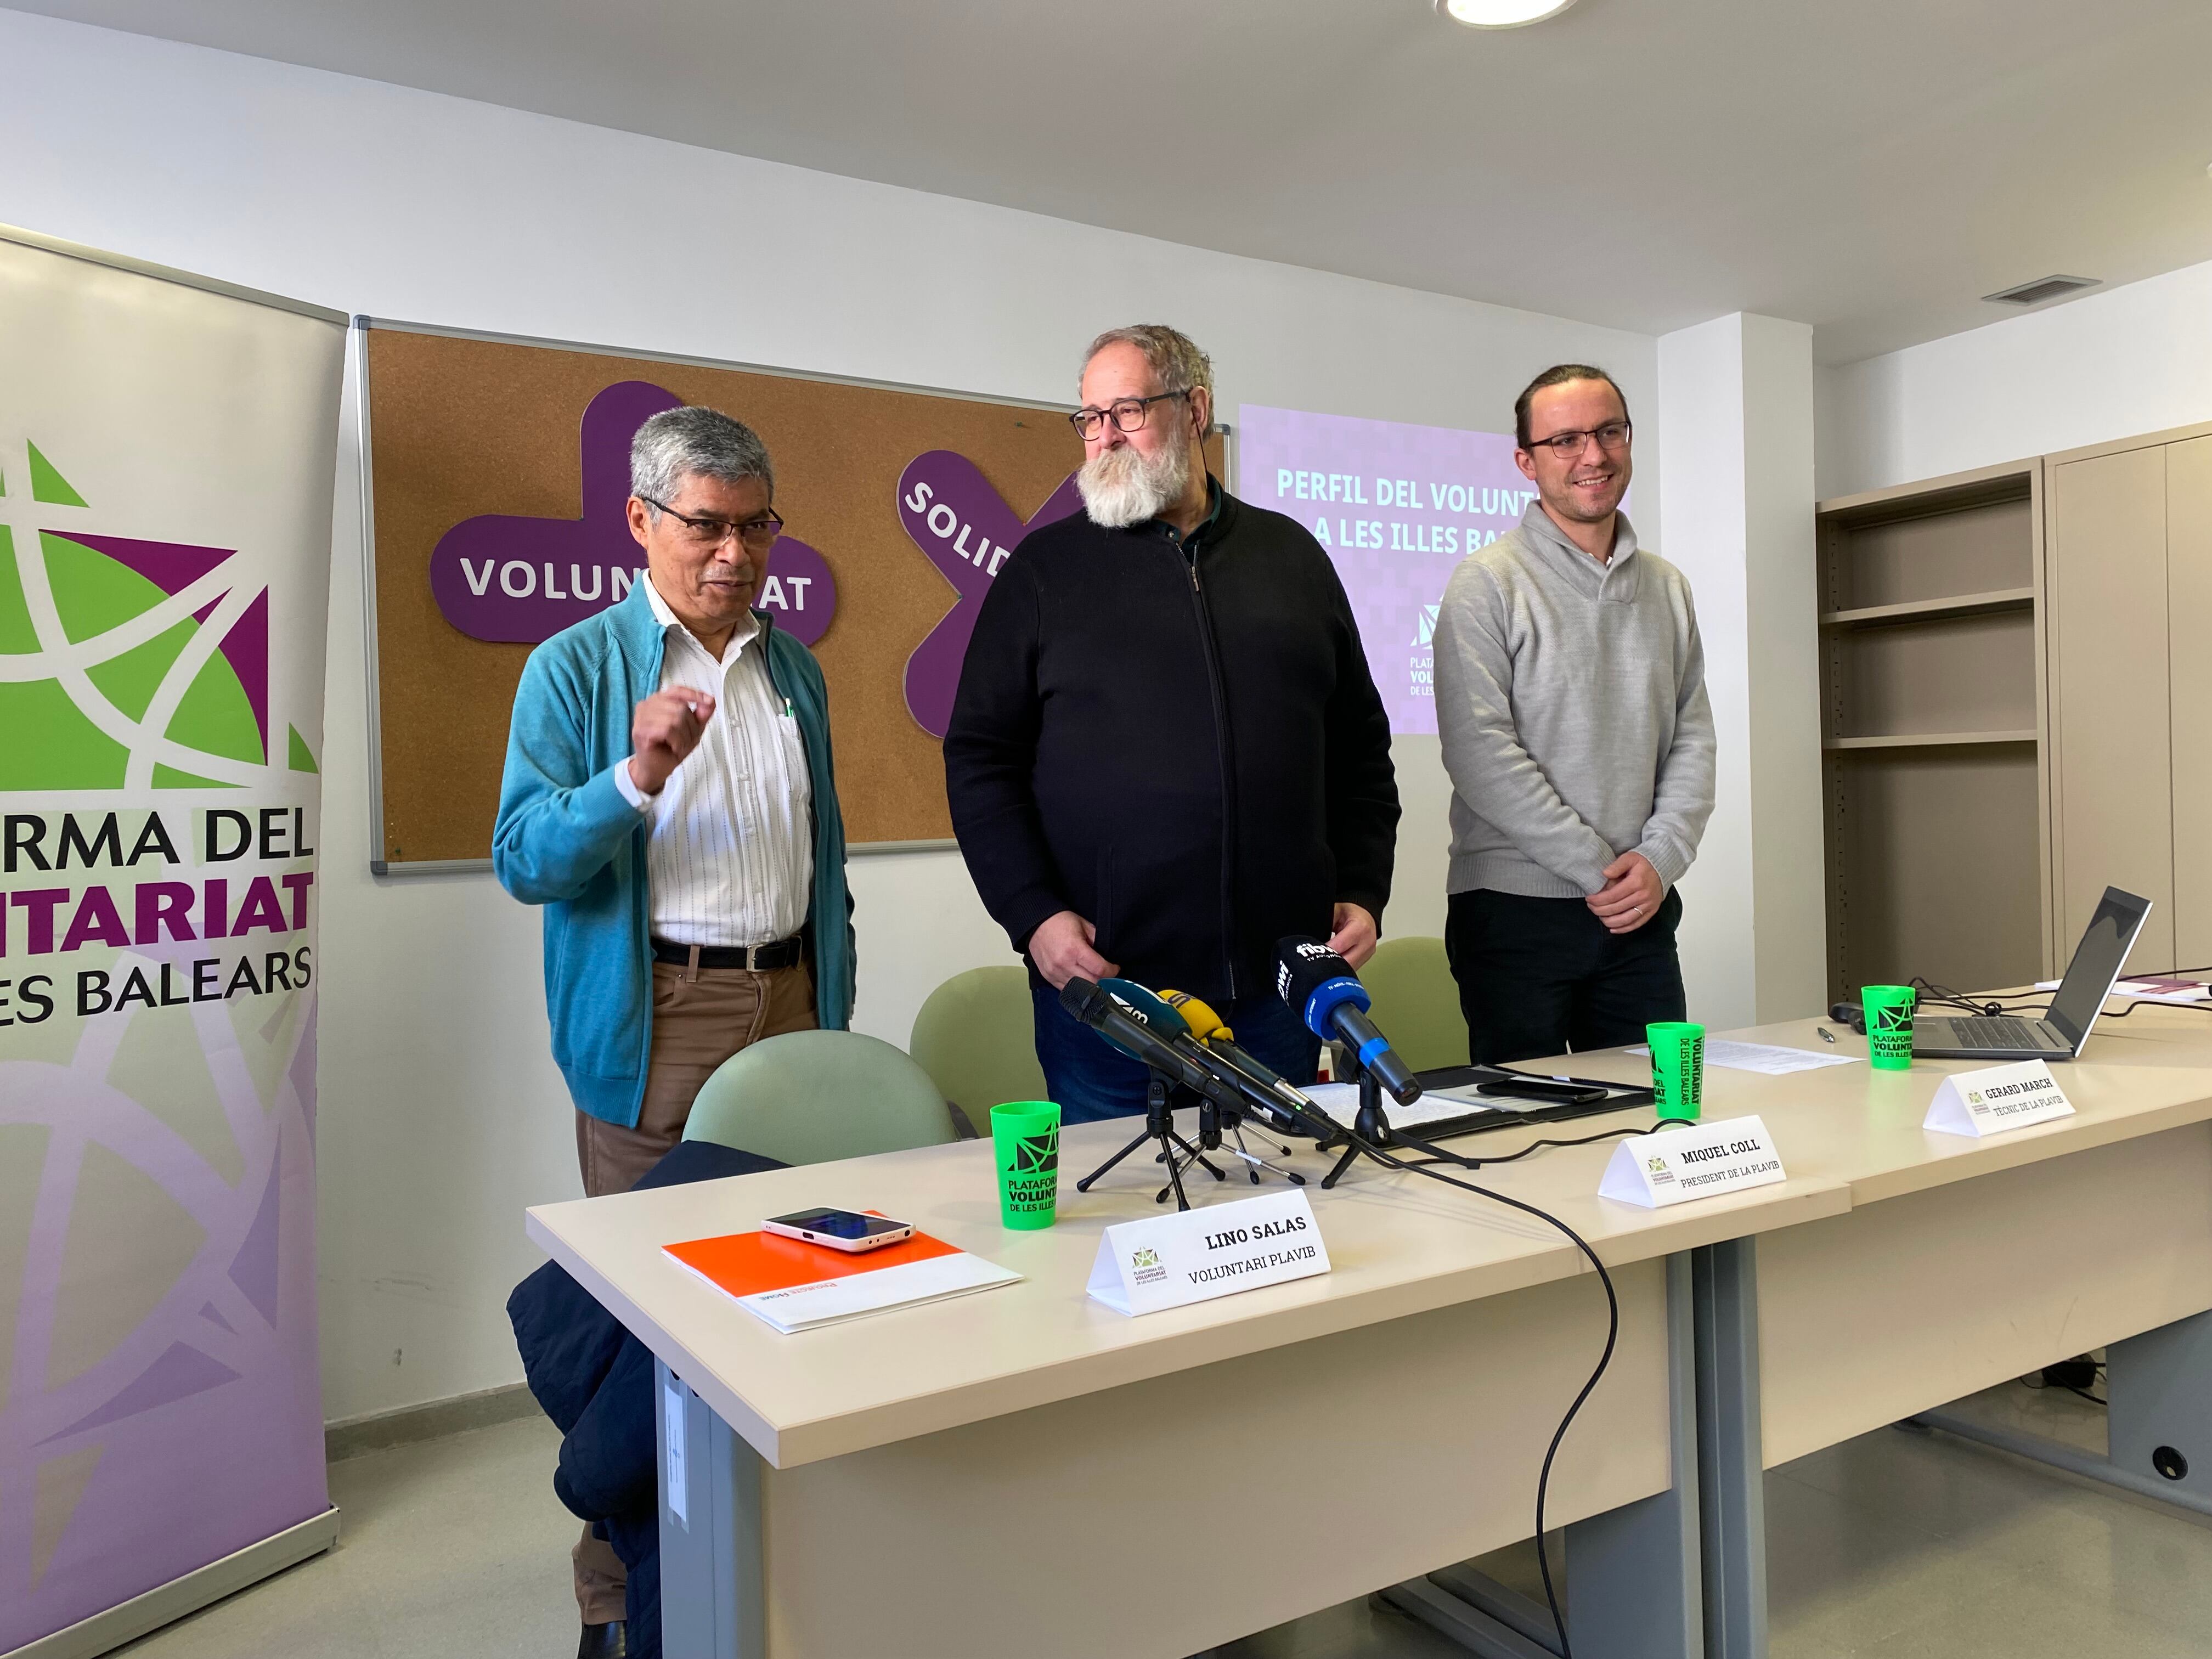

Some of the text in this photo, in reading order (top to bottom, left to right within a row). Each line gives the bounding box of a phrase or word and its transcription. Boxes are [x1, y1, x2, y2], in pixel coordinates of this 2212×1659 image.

[1277, 468, 1541, 517] PERFIL DEL VOLUNT
[1314, 517, 1505, 555] A LES ILLES BA
[460, 557, 812, 611] VOLUNAT
[1410, 685, 1420, 696] DE
[205, 807, 314, 862] DEL
[0, 871, 314, 958] TARIAT
[77, 946, 312, 1017] BALEARS
[1691, 1036, 1702, 1104] VOLUNTARIAT
[1681, 1077, 1690, 1105] BALEARS
[1985, 1077, 2053, 1099] GERARD MARCH
[2019, 1102, 2029, 1111] DE
[2029, 1099, 2039, 1109] LA
[2039, 1095, 2064, 1108] PLAVIB
[1680, 1138, 1761, 1165] MIQUEL COLL
[1680, 1170, 1727, 1189] PRESIDENT
[1728, 1167, 1740, 1179] DE
[1741, 1165, 1752, 1176] LA
[1751, 1160, 1780, 1175] PLAVIB
[1009, 1187, 1057, 1203] VOLUNT
[1010, 1204, 1020, 1212] DE
[1022, 1203, 1037, 1212] LES
[1039, 1200, 1054, 1211] ILLES
[1204, 1216, 1307, 1250] LINO SALAS
[1133, 1266, 1158, 1276] PLATAFORMA
[1135, 1270, 1166, 1281] VOLUNTARIAT
[1188, 1245, 1316, 1285] VOLUNTARI PLAVIB
